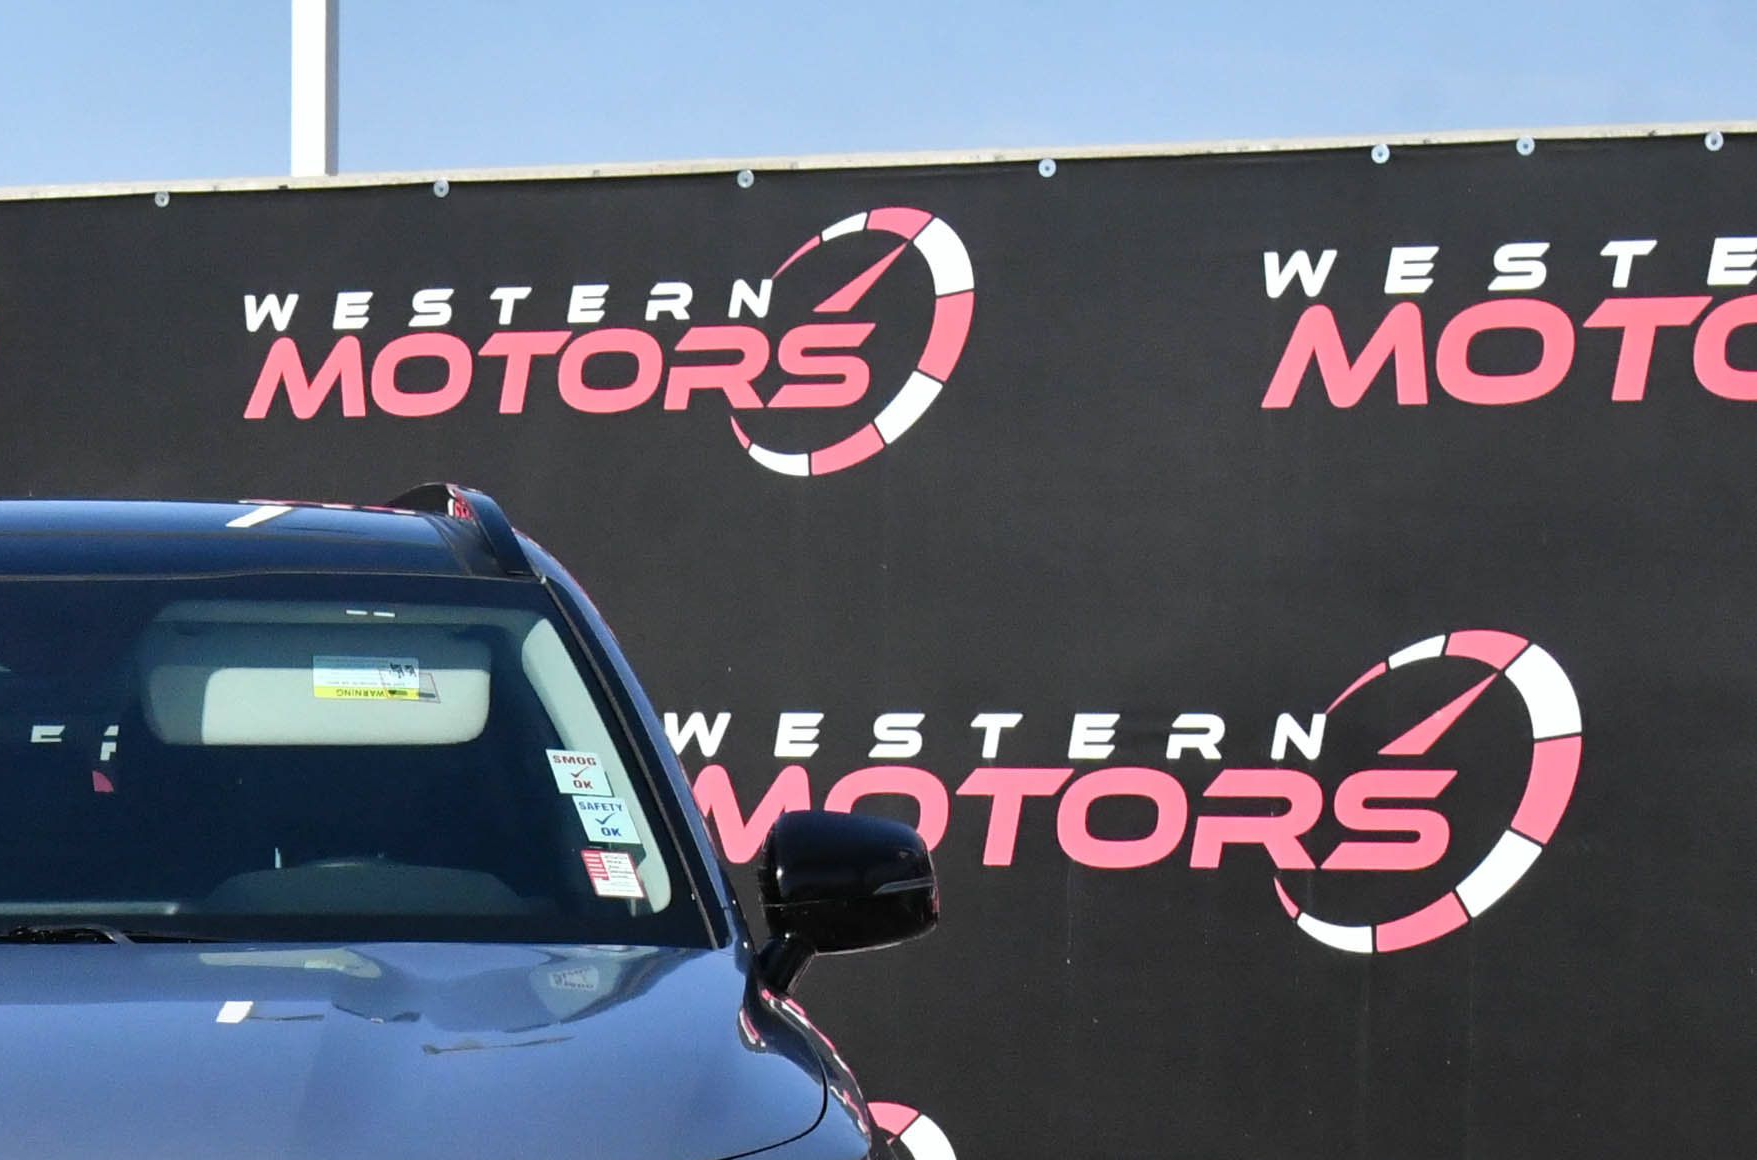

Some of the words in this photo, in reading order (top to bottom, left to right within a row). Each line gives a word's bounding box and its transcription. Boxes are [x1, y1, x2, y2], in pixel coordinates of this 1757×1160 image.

[244, 278, 773, 333] WESTERN
[244, 322, 876, 420] MOTORS
[663, 711, 1327, 761] WESTERN
[552, 754, 597, 766] SMOG
[573, 779, 594, 790] OK
[578, 801, 623, 812] SAFETY
[692, 764, 1458, 871] MOTORS
[600, 826, 622, 837] OK
